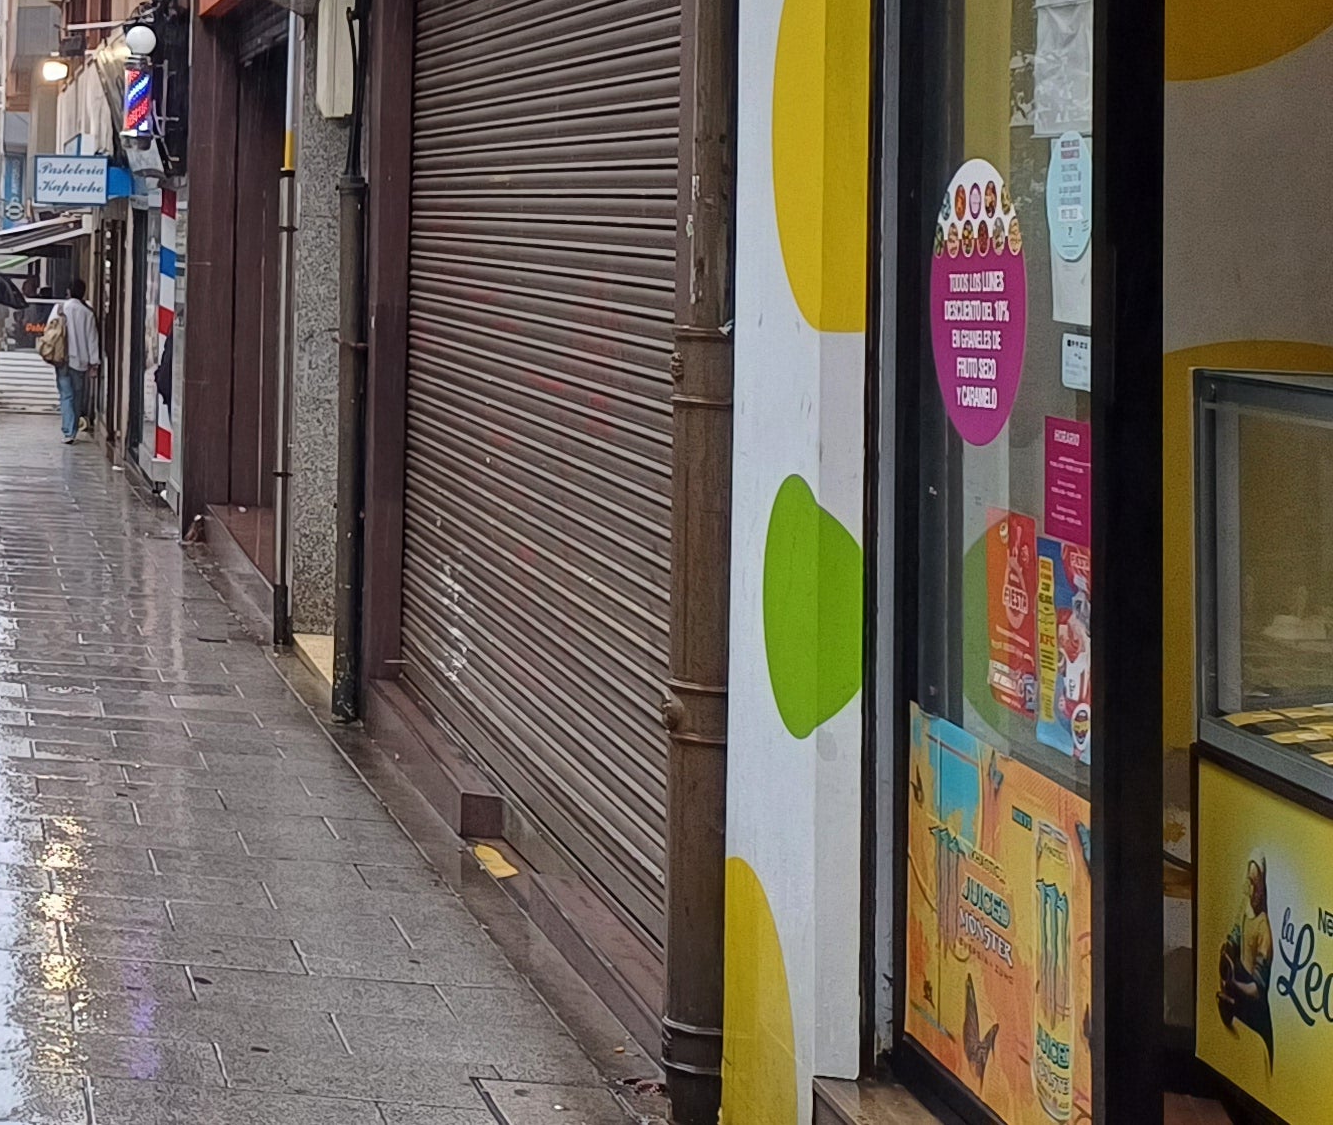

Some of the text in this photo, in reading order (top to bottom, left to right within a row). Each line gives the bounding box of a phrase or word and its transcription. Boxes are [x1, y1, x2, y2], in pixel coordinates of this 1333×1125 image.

[944, 300, 1010, 323] DESCUENTO DEL 10%
[956, 385, 998, 410] Y CARAMELO
